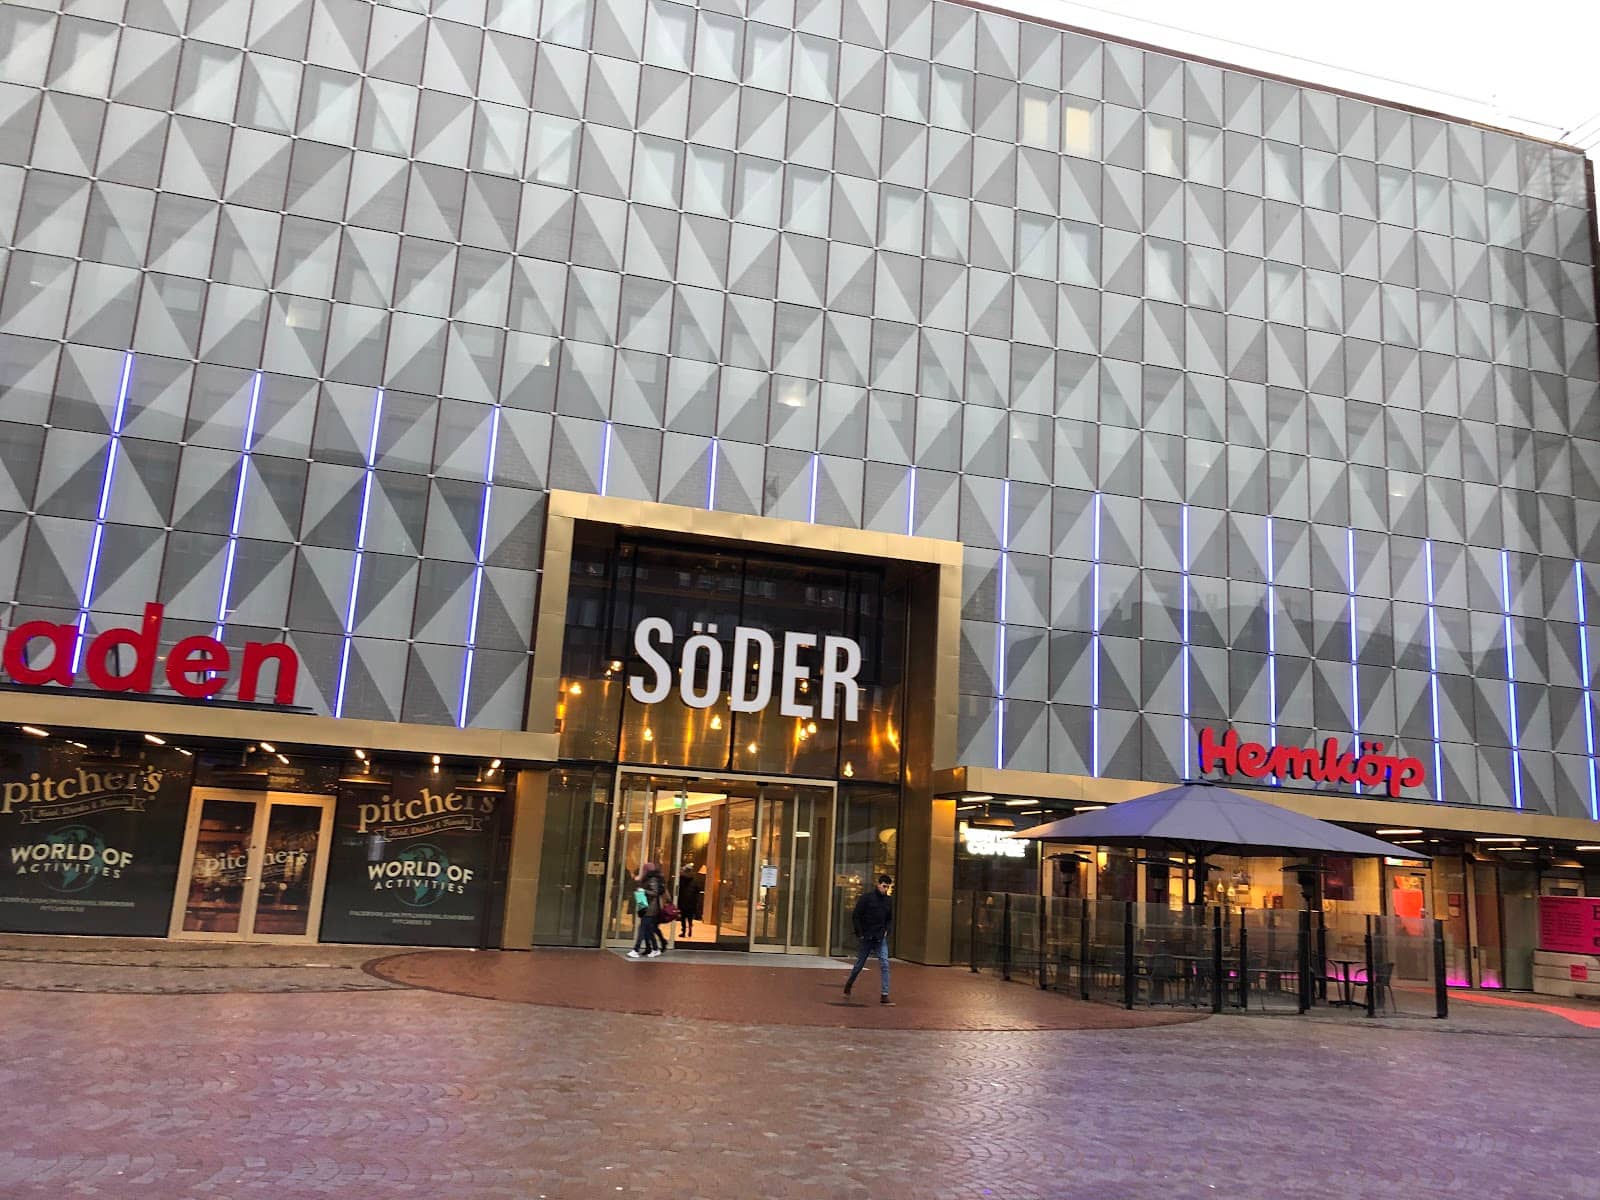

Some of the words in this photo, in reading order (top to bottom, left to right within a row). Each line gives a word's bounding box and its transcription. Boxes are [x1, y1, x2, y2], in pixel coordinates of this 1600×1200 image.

[629, 616, 862, 722] SÖDER
[1200, 726, 1425, 798] Hemköp
[357, 788, 495, 833] pitchers
[10, 843, 95, 864] WORLD
[101, 847, 134, 868] OF
[16, 862, 121, 879] ACTIVITIES
[367, 860, 441, 881] WORLD
[446, 865, 474, 884] OF
[373, 879, 465, 895] ACTIVITIES
